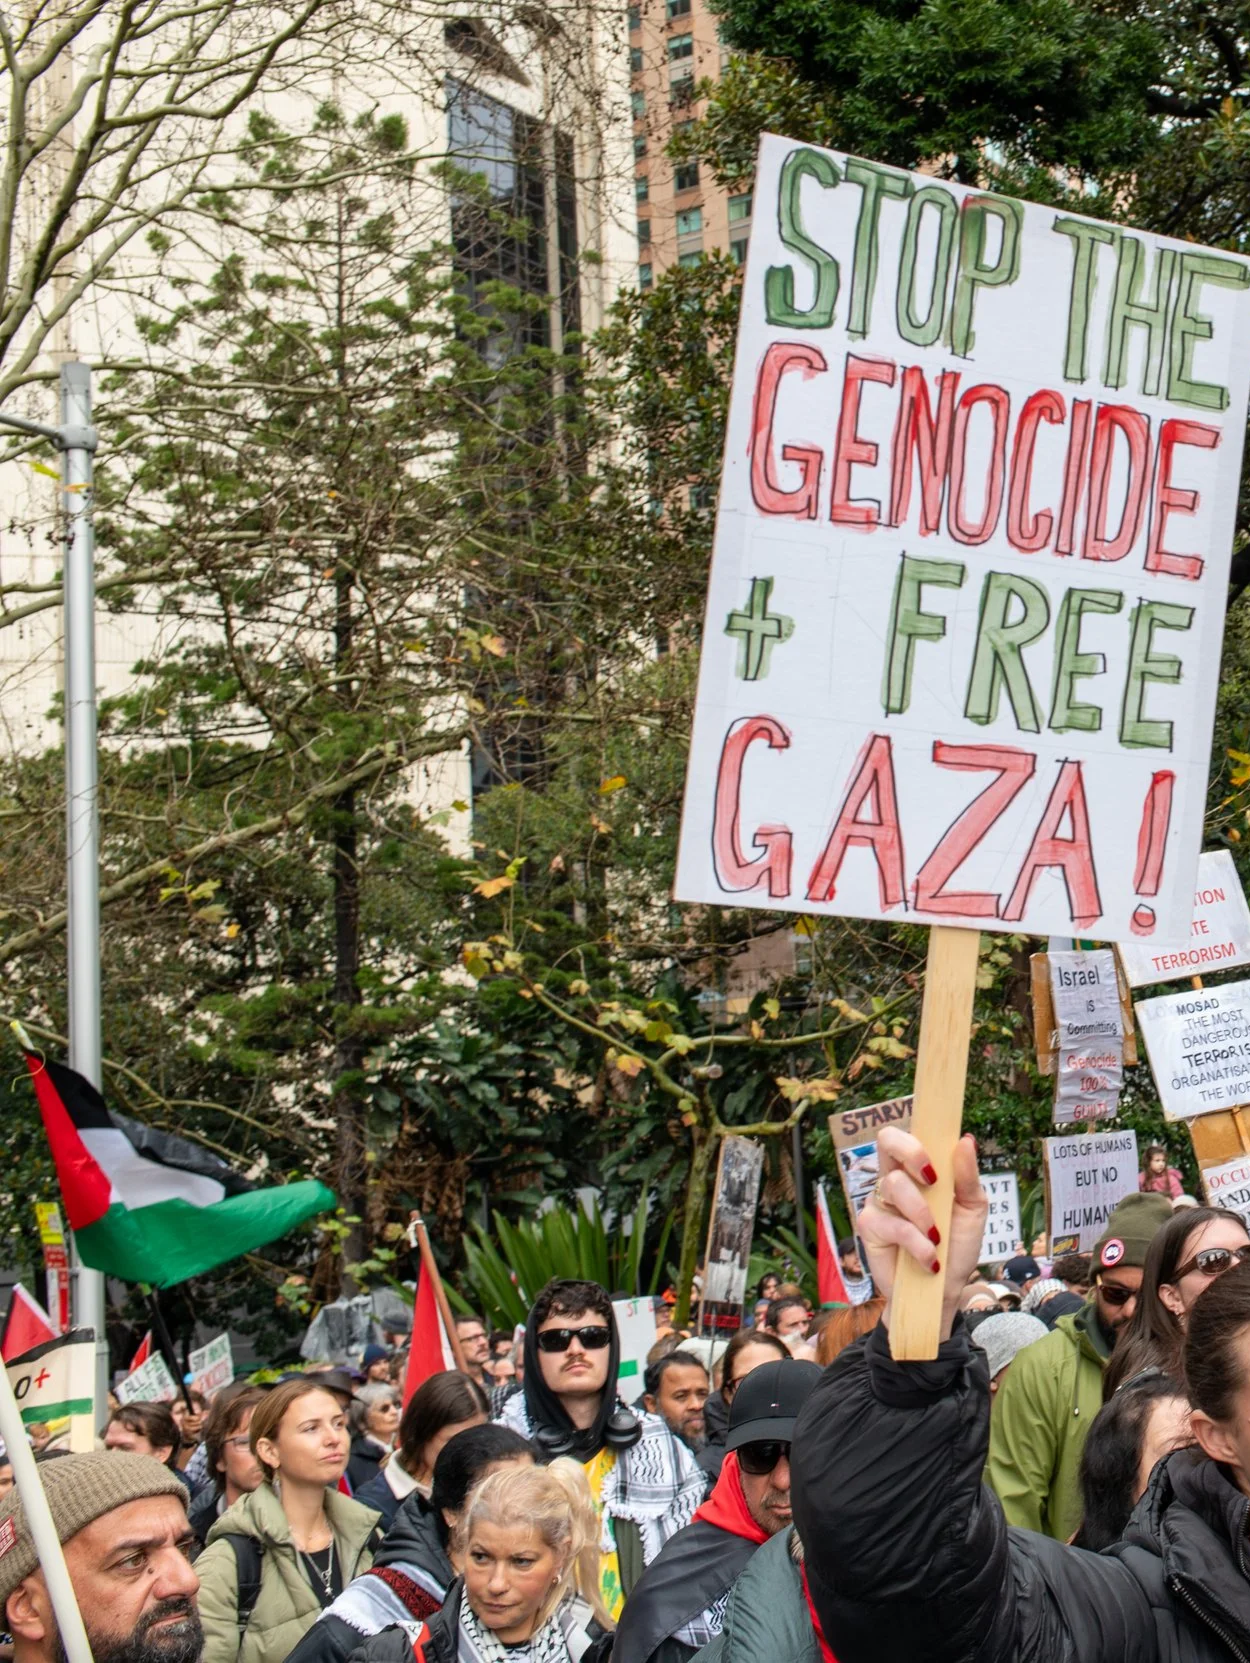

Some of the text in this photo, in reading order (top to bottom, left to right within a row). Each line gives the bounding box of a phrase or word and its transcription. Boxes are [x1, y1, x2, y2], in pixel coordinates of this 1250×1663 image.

[764, 147, 1025, 360] STOP
[746, 340, 1222, 581] GENOCIDE
[881, 550, 1196, 754] FREE
[712, 714, 1175, 937] GAZA!
[1152, 942, 1237, 972] TERRORISM
[1058, 965, 1100, 988] Israel
[1176, 998, 1220, 1016] MOSAD
[1067, 1022, 1118, 1036] Committing
[1185, 1009, 1244, 1031] THE MOST
[1067, 1054, 1118, 1070] Genocide
[1199, 1088, 1225, 1103] THE
[1053, 1138, 1133, 1160] LOTS OF HUMANS
[1076, 1166, 1118, 1187] BUT NO
